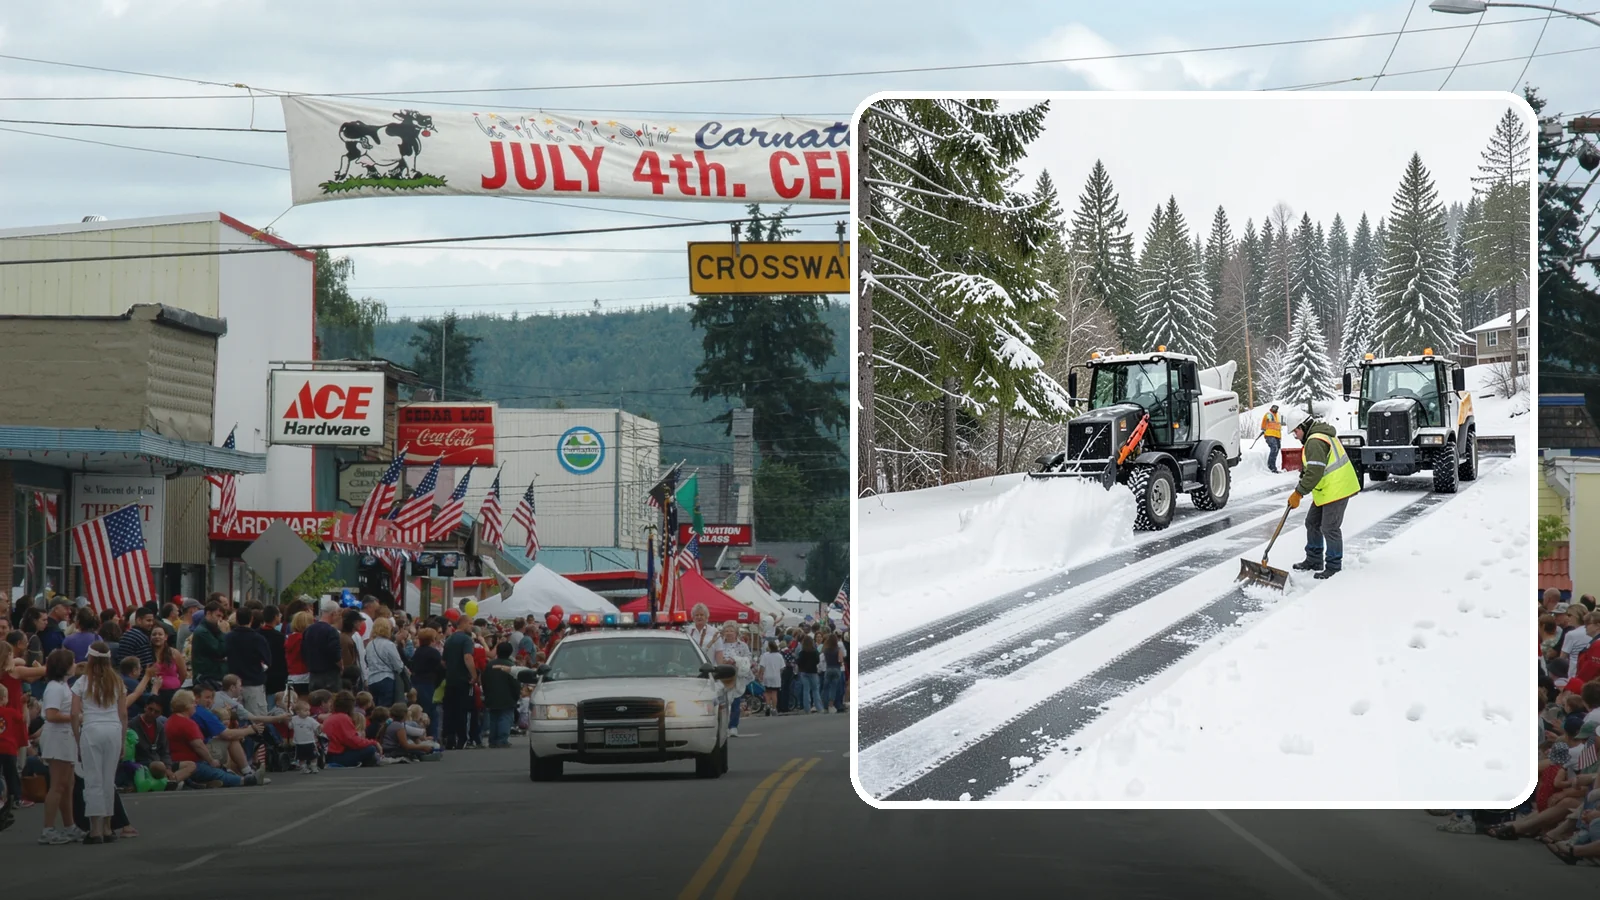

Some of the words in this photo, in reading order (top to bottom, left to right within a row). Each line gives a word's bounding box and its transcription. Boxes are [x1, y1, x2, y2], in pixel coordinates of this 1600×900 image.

[480, 140, 605, 192] JULY
[631, 149, 746, 197] 4th.
[696, 253, 850, 280] CROSSWA
[282, 379, 374, 420] ACE
[405, 409, 452, 422] CEDAR
[461, 409, 485, 422] LOG
[283, 421, 371, 437] Hardware
[416, 428, 477, 447] Coca-Cola
[96, 485, 124, 495] Vincent
[126, 485, 135, 495] de
[138, 485, 155, 495] Paul
[688, 526, 742, 535] CRNATION
[699, 534, 731, 543] GLASS
